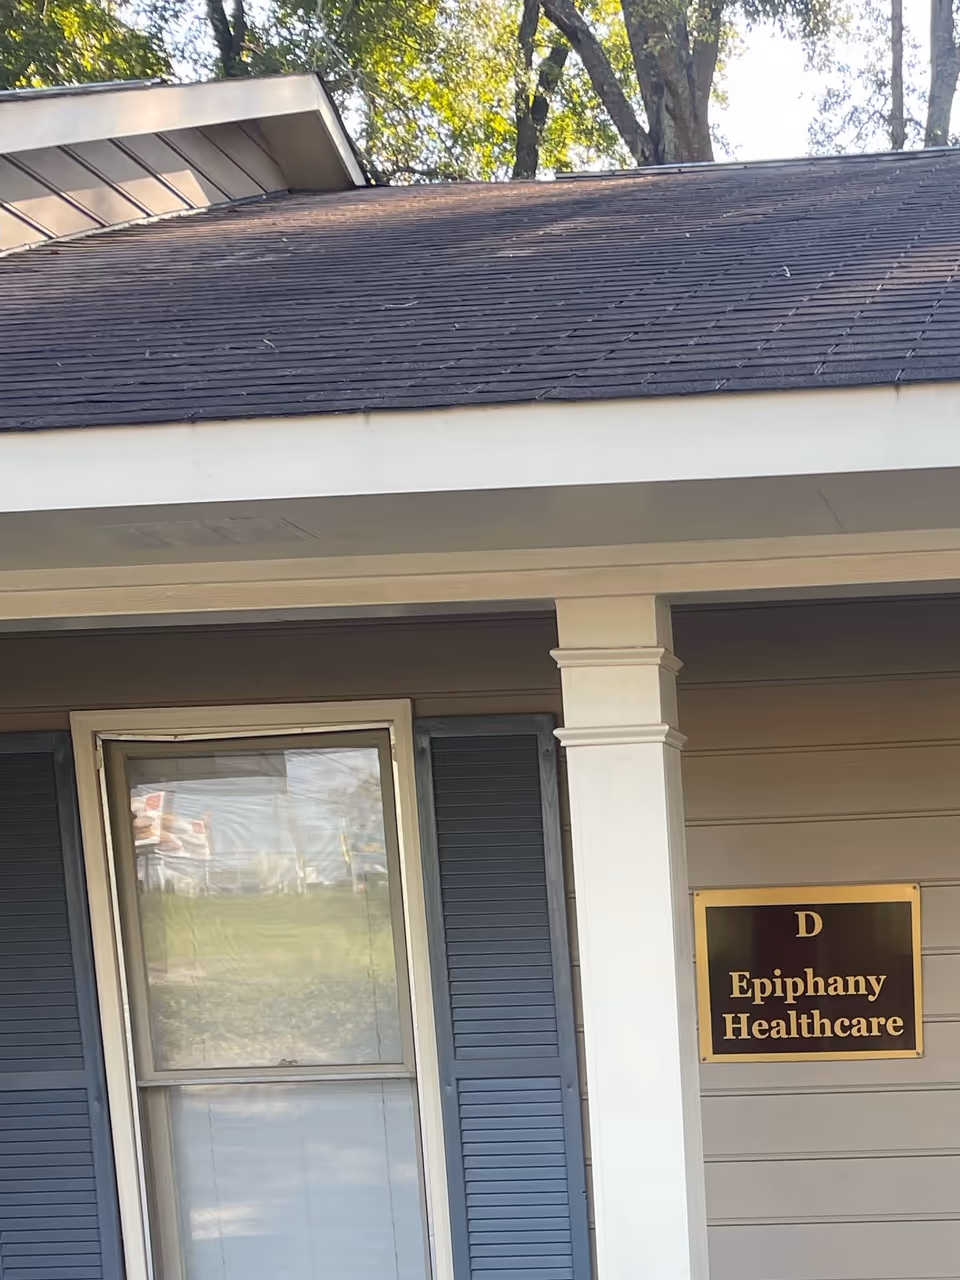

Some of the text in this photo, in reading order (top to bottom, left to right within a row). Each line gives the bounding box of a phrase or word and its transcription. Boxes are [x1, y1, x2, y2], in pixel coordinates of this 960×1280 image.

[794, 911, 823, 938] D
[728, 968, 887, 1004] Epiphany
[722, 1010, 904, 1040] Healthcare
